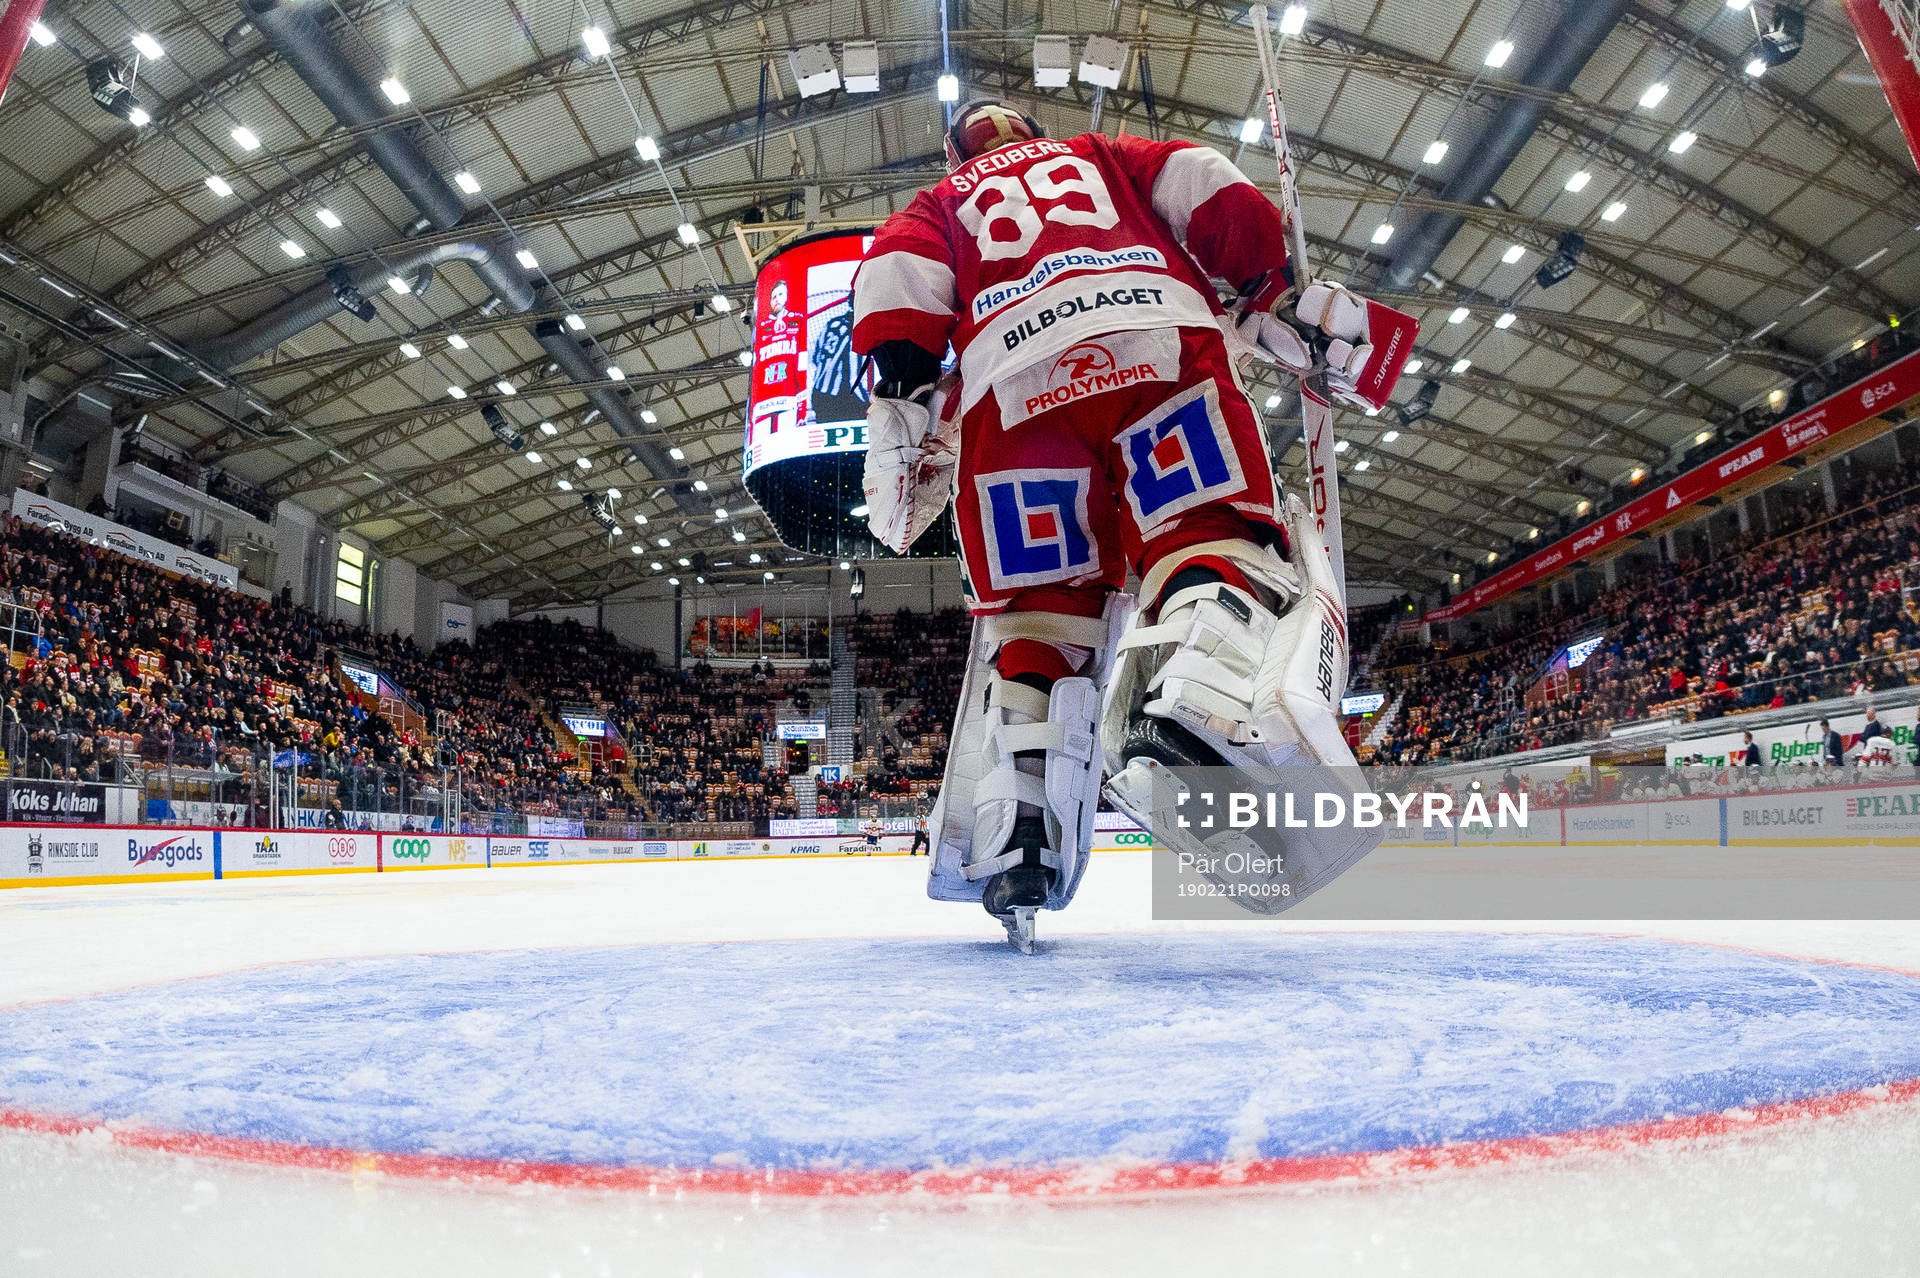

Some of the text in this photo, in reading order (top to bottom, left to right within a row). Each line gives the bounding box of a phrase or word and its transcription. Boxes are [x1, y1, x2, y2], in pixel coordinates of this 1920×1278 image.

[950, 139, 1073, 193] SVEDBERG
[956, 155, 1120, 262] 89
[976, 248, 1159, 316] Handelsbanken
[1002, 288, 1164, 351] BILBOLAGET
[1024, 363, 1160, 416] PROLYMPIA
[27, 507, 94, 537] Faradium Bygg AB
[1316, 619, 1335, 702] BAUER
[1771, 741, 1824, 764] Byber
[10, 788, 99, 812] Köks Johan
[1572, 817, 1635, 831] Handelsbanken
[1743, 807, 1824, 826] BILBOLAGET
[48, 842, 99, 858] RINKSIDE CLUB
[128, 838, 203, 867] Bussgods
[255, 841, 278, 853] TAXI
[393, 839, 431, 863] coop
[528, 841, 549, 857] SSE
[790, 845, 820, 853] KPMG
[839, 844, 882, 855] Faradim
